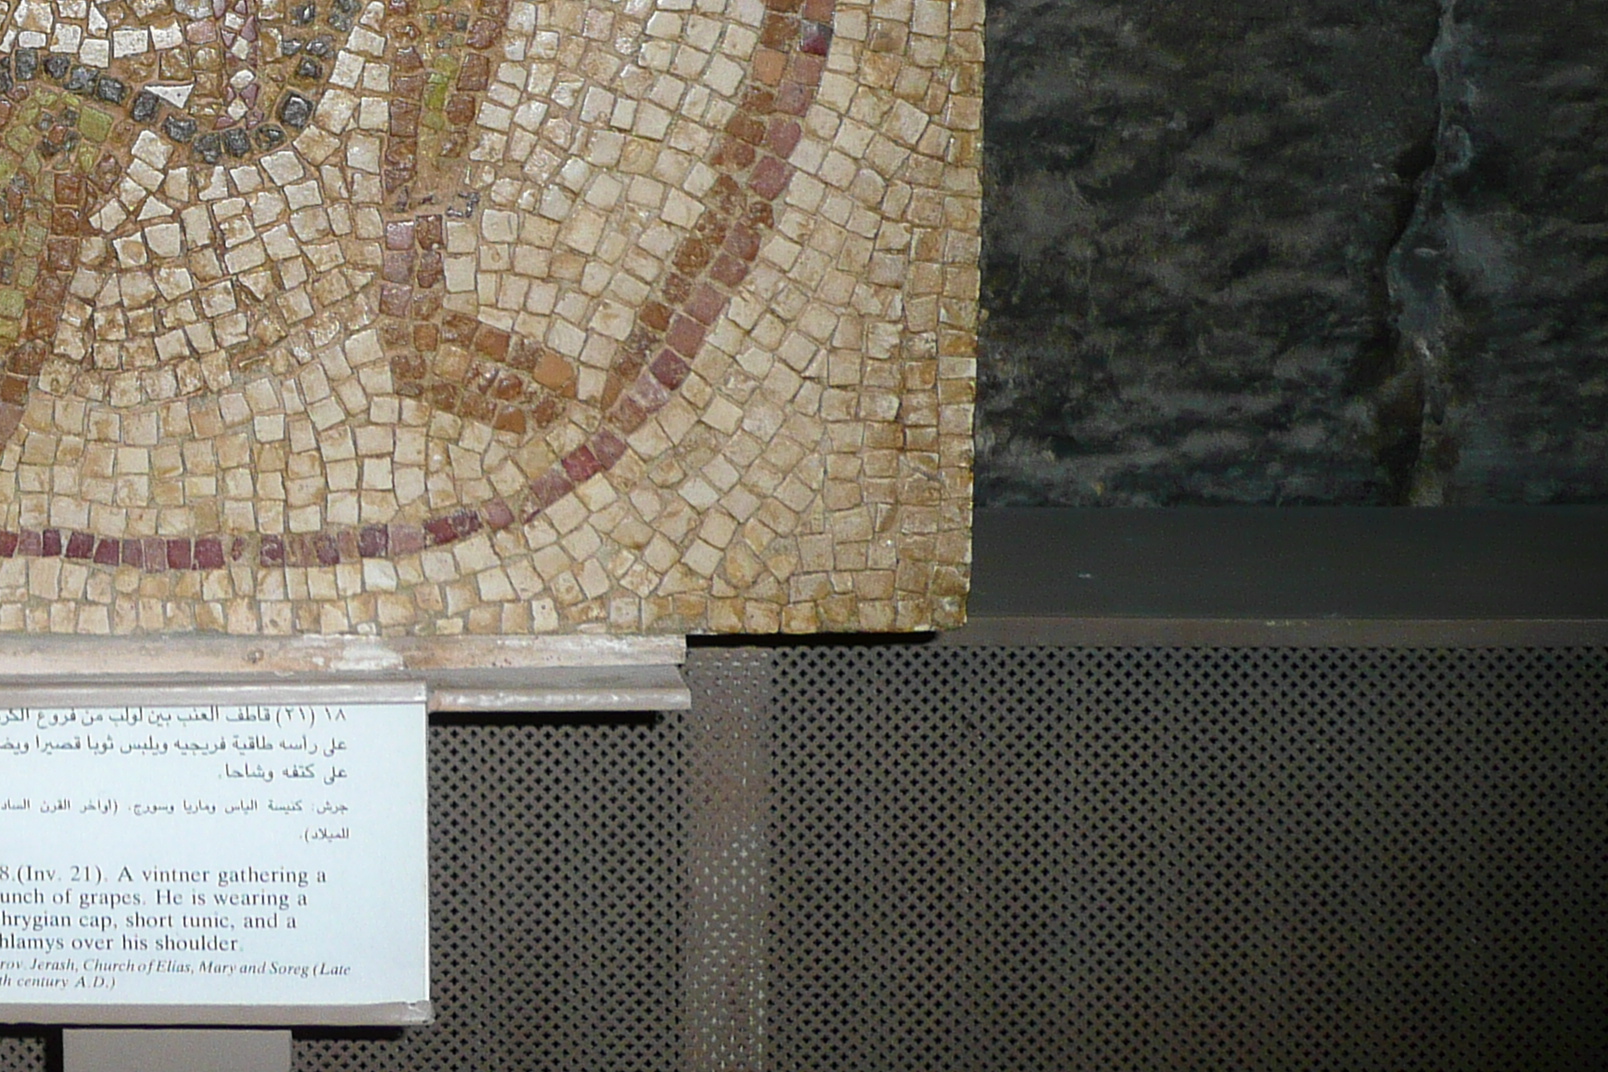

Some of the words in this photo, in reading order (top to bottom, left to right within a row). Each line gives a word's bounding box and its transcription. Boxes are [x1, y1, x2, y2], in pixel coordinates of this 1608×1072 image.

[37, 708, 76, 729] فروع
[81, 710, 103, 726] من
[109, 706, 143, 727] لولب
[148, 710, 172, 727] بين
[177, 705, 219, 727] العنب
[226, 705, 270, 722] قاطف
[36, 734, 81, 755] قصيرا
[87, 734, 114, 755] ثوبا
[120, 735, 168, 756] ويلبس
[174, 736, 227, 756] فريجيه
[232, 734, 273, 756] طاقية
[323, 737, 347, 758] على
[283, 763, 316, 779] كتفه
[323, 766, 348, 785] على
[40, 798, 71, 815] القرن
[183, 799, 216, 815] وماريا
[225, 799, 258, 815] الياس
[268, 799, 303, 815] كنيسة
[70, 865, 108, 885] 21).
[117, 866, 133, 882] A
[142, 866, 210, 883] vintner
[218, 866, 309, 888] gathering
[316, 871, 327, 883] a
[52, 888, 72, 905] of
[79, 892, 147, 909] grapes.
[156, 889, 183, 906] He
[191, 889, 206, 906] is
[214, 890, 290, 910] wearing
[297, 893, 308, 906] a
[79, 915, 118, 932] cap,
[125, 912, 173, 928] short
[182, 912, 236, 931] tunic,
[243, 912, 278, 929] and
[286, 916, 297, 929] a
[71, 937, 114, 950] over
[122, 934, 148, 951] his
[30, 958, 79, 973] Jerash,
[83, 958, 135, 972] Church
[137, 959, 155, 975] of
[156, 959, 195, 975] Elias,
[199, 960, 237, 976] Mary
[240, 961, 266, 975] and
[269, 961, 310, 978] Soreg
[312, 962, 351, 978] (Late
[17, 975, 69, 989] century
[74, 975, 116, 990] A.D.)
